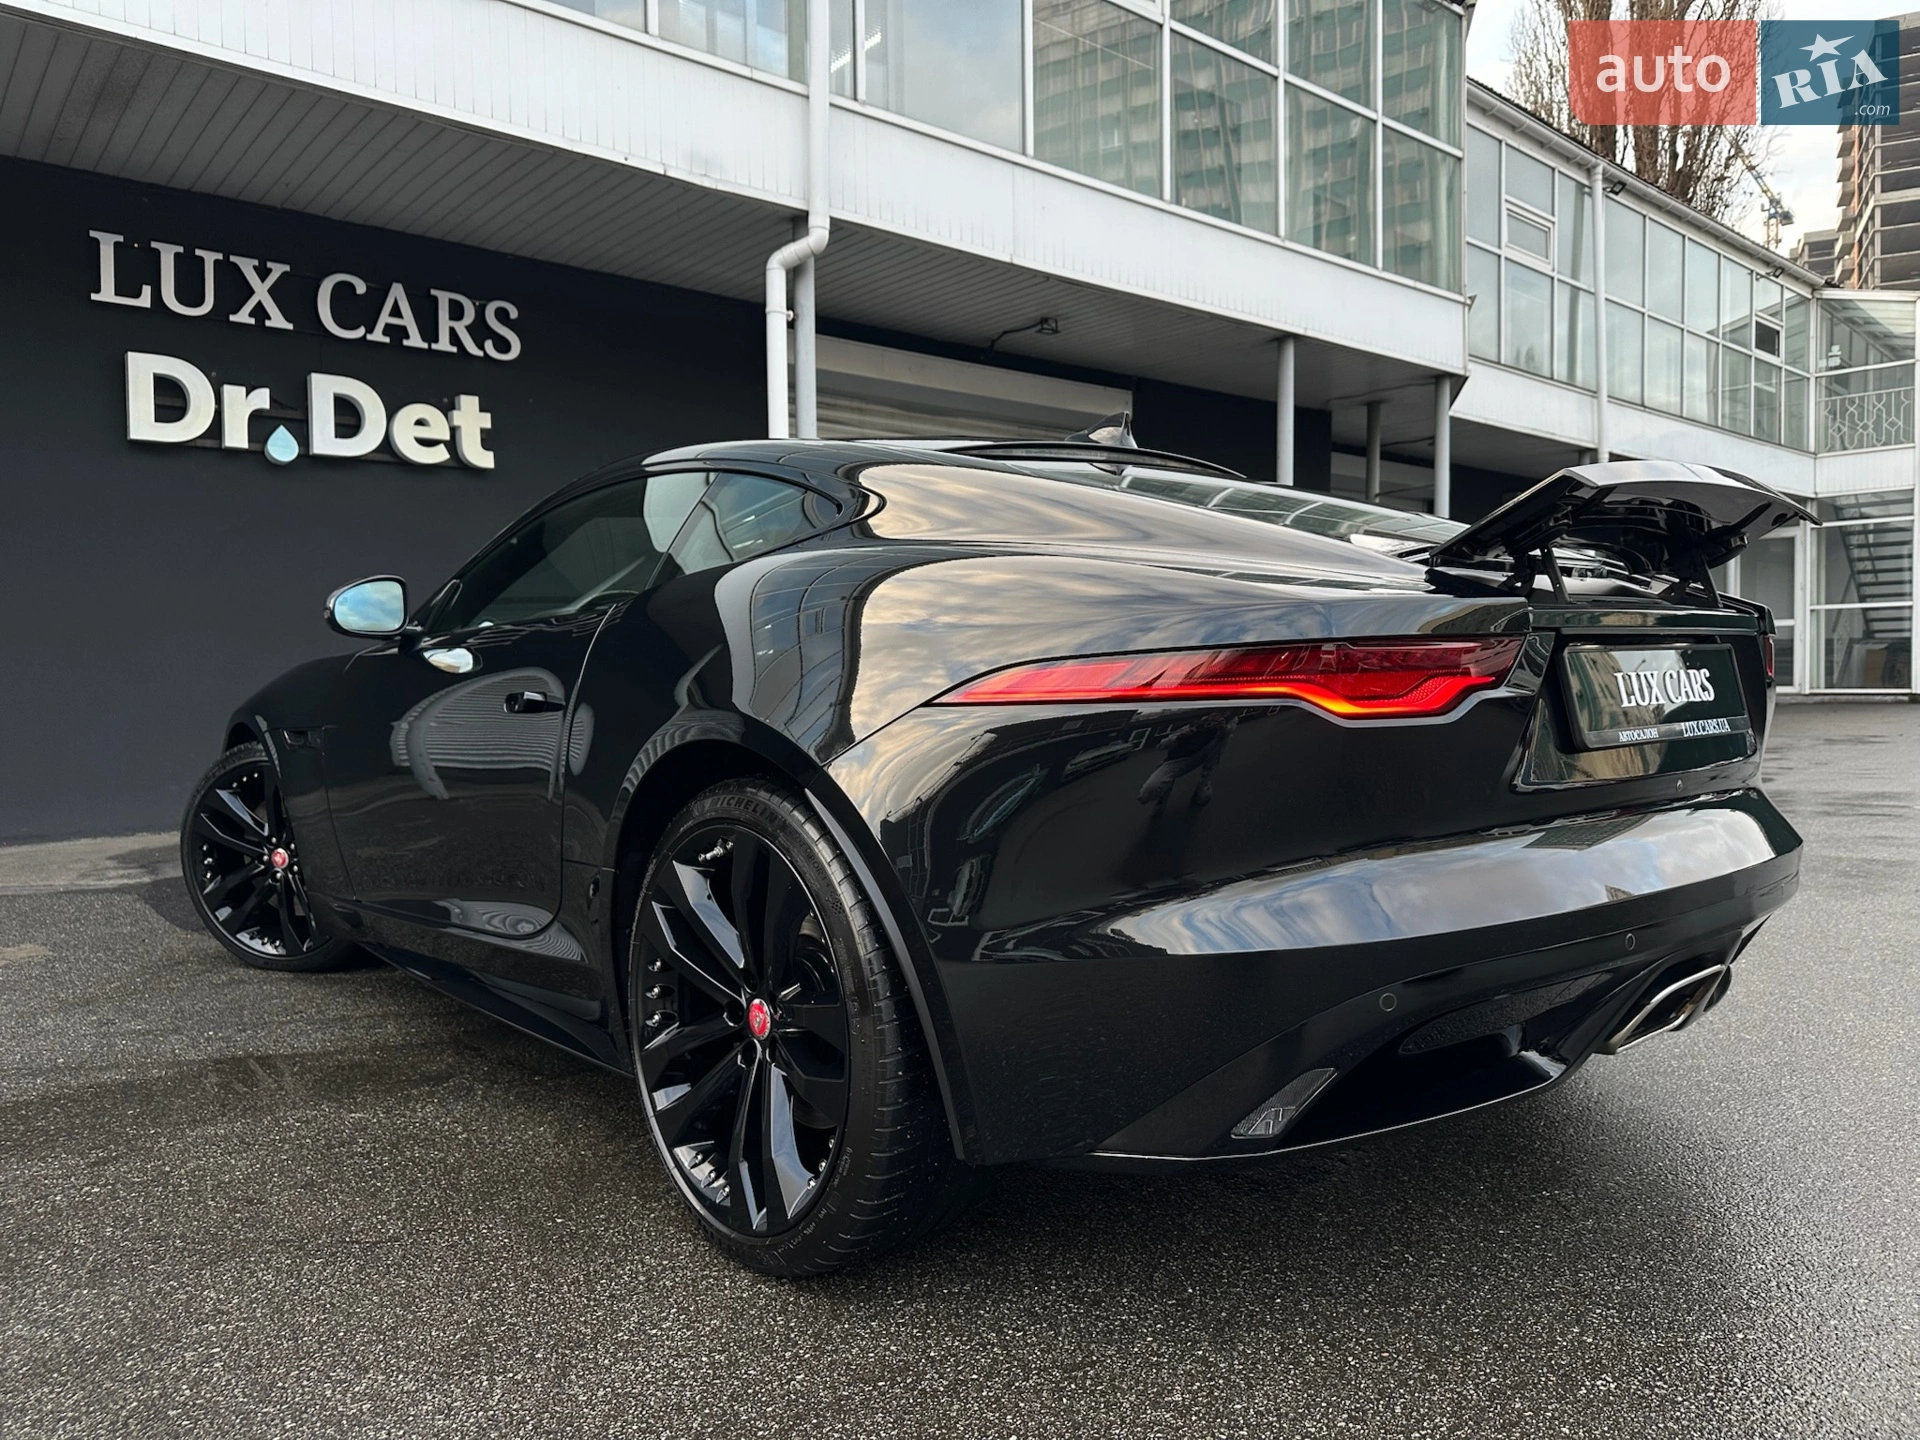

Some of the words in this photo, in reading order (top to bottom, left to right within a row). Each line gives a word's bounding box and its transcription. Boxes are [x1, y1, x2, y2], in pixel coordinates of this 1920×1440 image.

[89, 229, 294, 331] LUX
[316, 272, 522, 362] CARS
[1614, 671, 1667, 707] LUX
[1664, 668, 1715, 703] CARS
[1618, 728, 1660, 742] АВТОСАЛОН
[709, 796, 780, 825] MICHELIN
